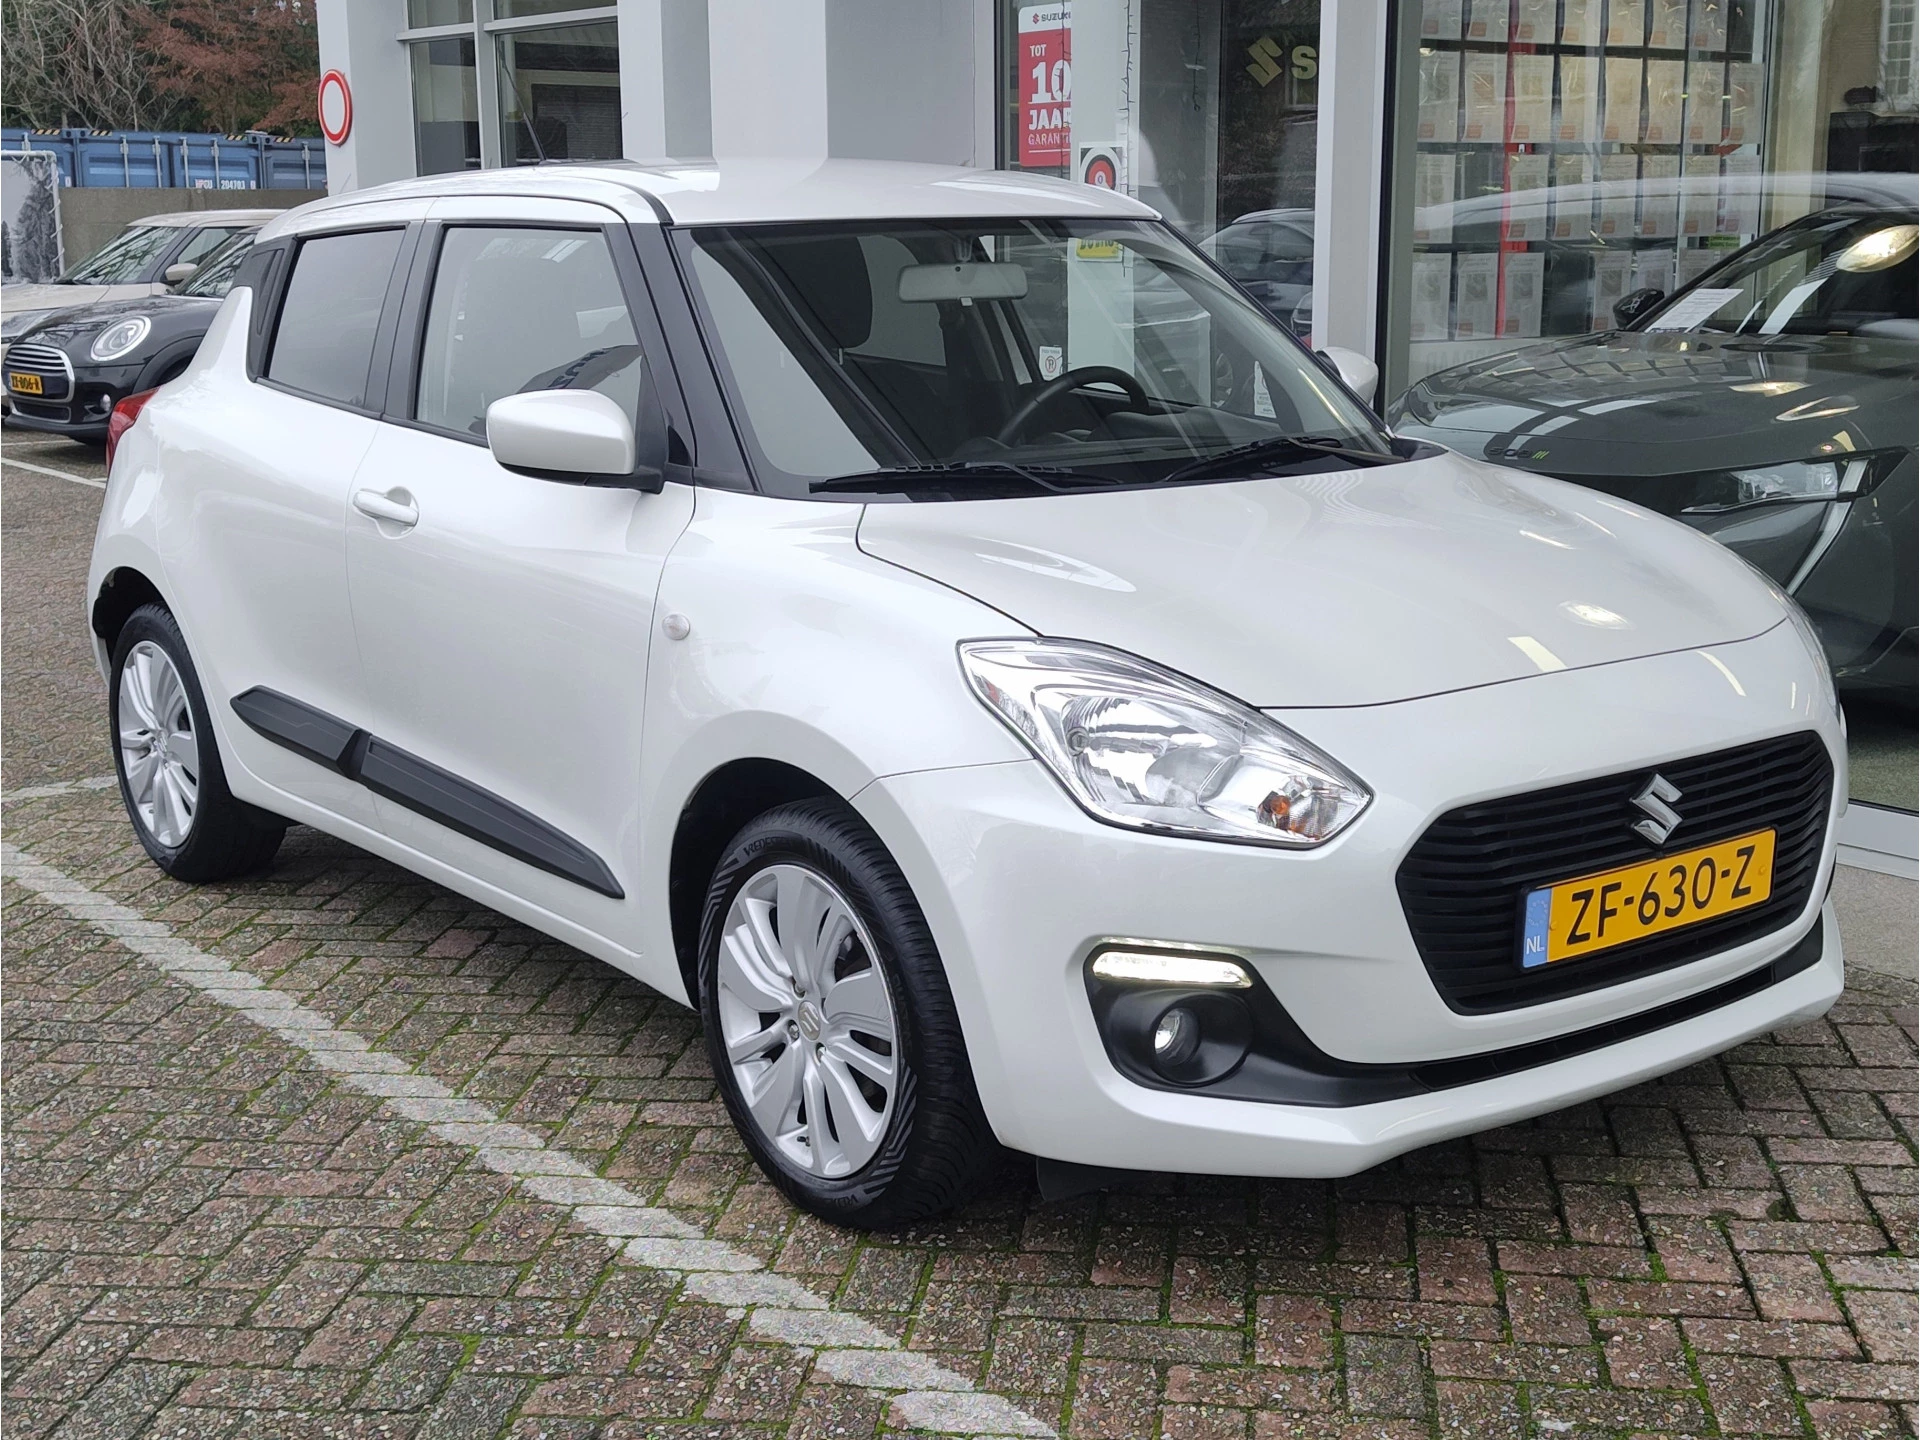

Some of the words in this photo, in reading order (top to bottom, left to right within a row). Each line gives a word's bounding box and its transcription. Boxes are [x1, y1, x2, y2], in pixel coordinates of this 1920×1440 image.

[1041, 11, 1071, 22] SUZUKI
[1030, 43, 1047, 57] TOT
[1032, 59, 1071, 103] 10
[1566, 844, 1756, 946] ZF-630-Z
[1526, 935, 1545, 955] NL
